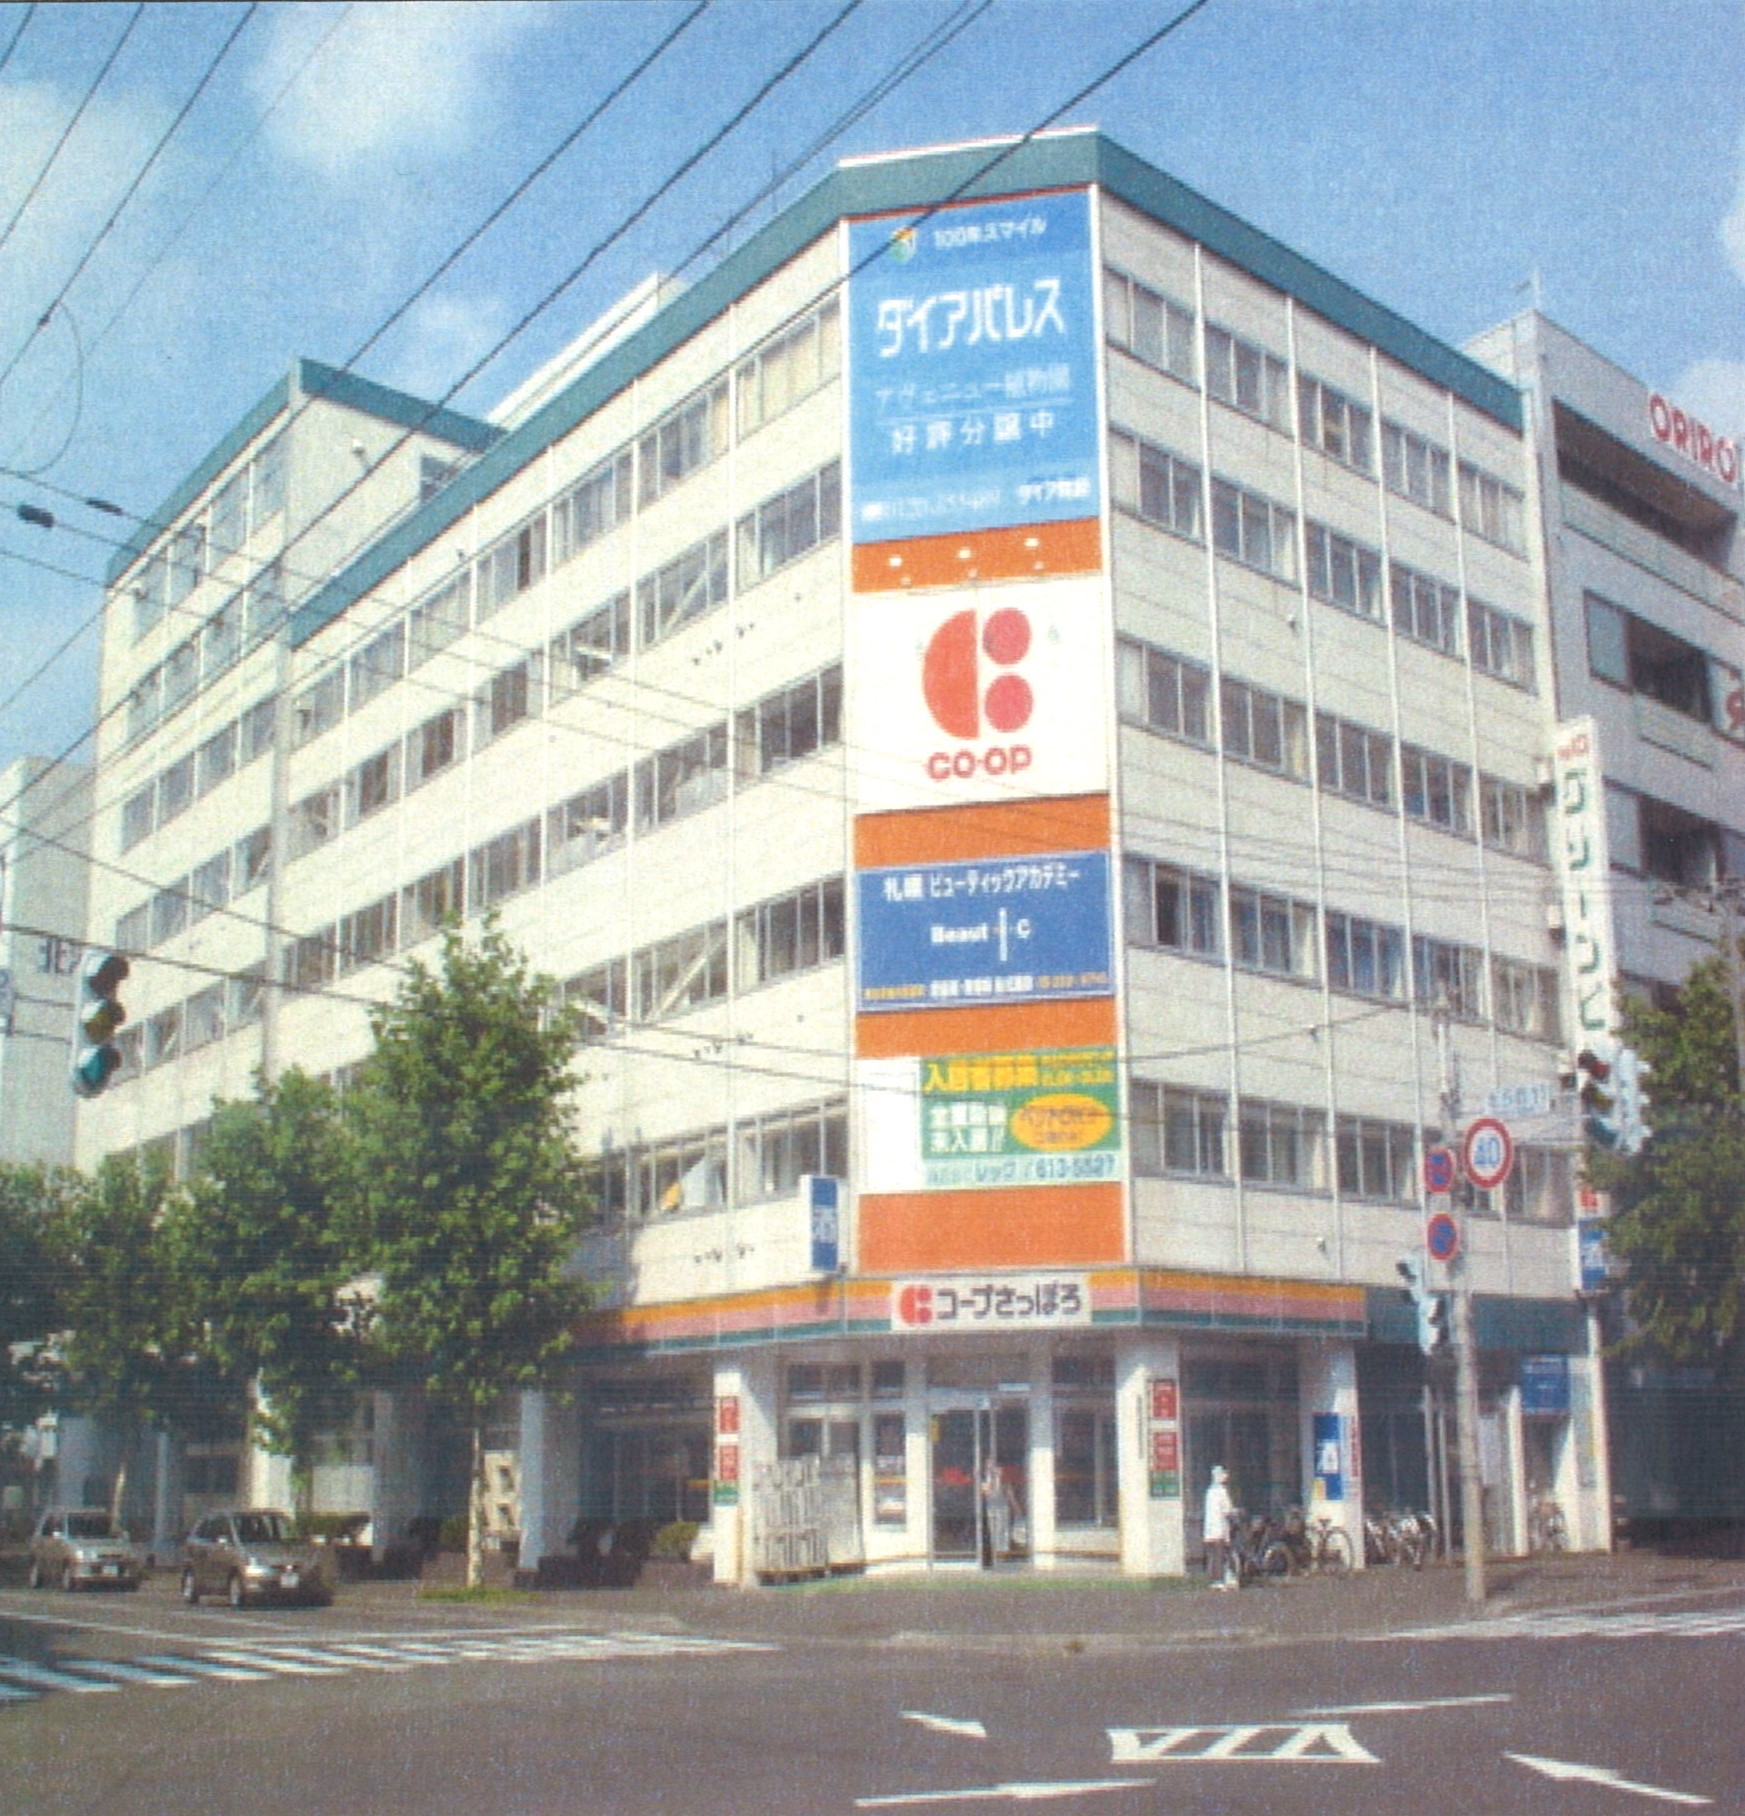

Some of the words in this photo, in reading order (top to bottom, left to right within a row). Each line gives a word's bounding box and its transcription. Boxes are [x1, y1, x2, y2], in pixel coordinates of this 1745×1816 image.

[877, 275, 1066, 359] ダイアパレス
[937, 1281, 1081, 1320] コープさっぽろ
